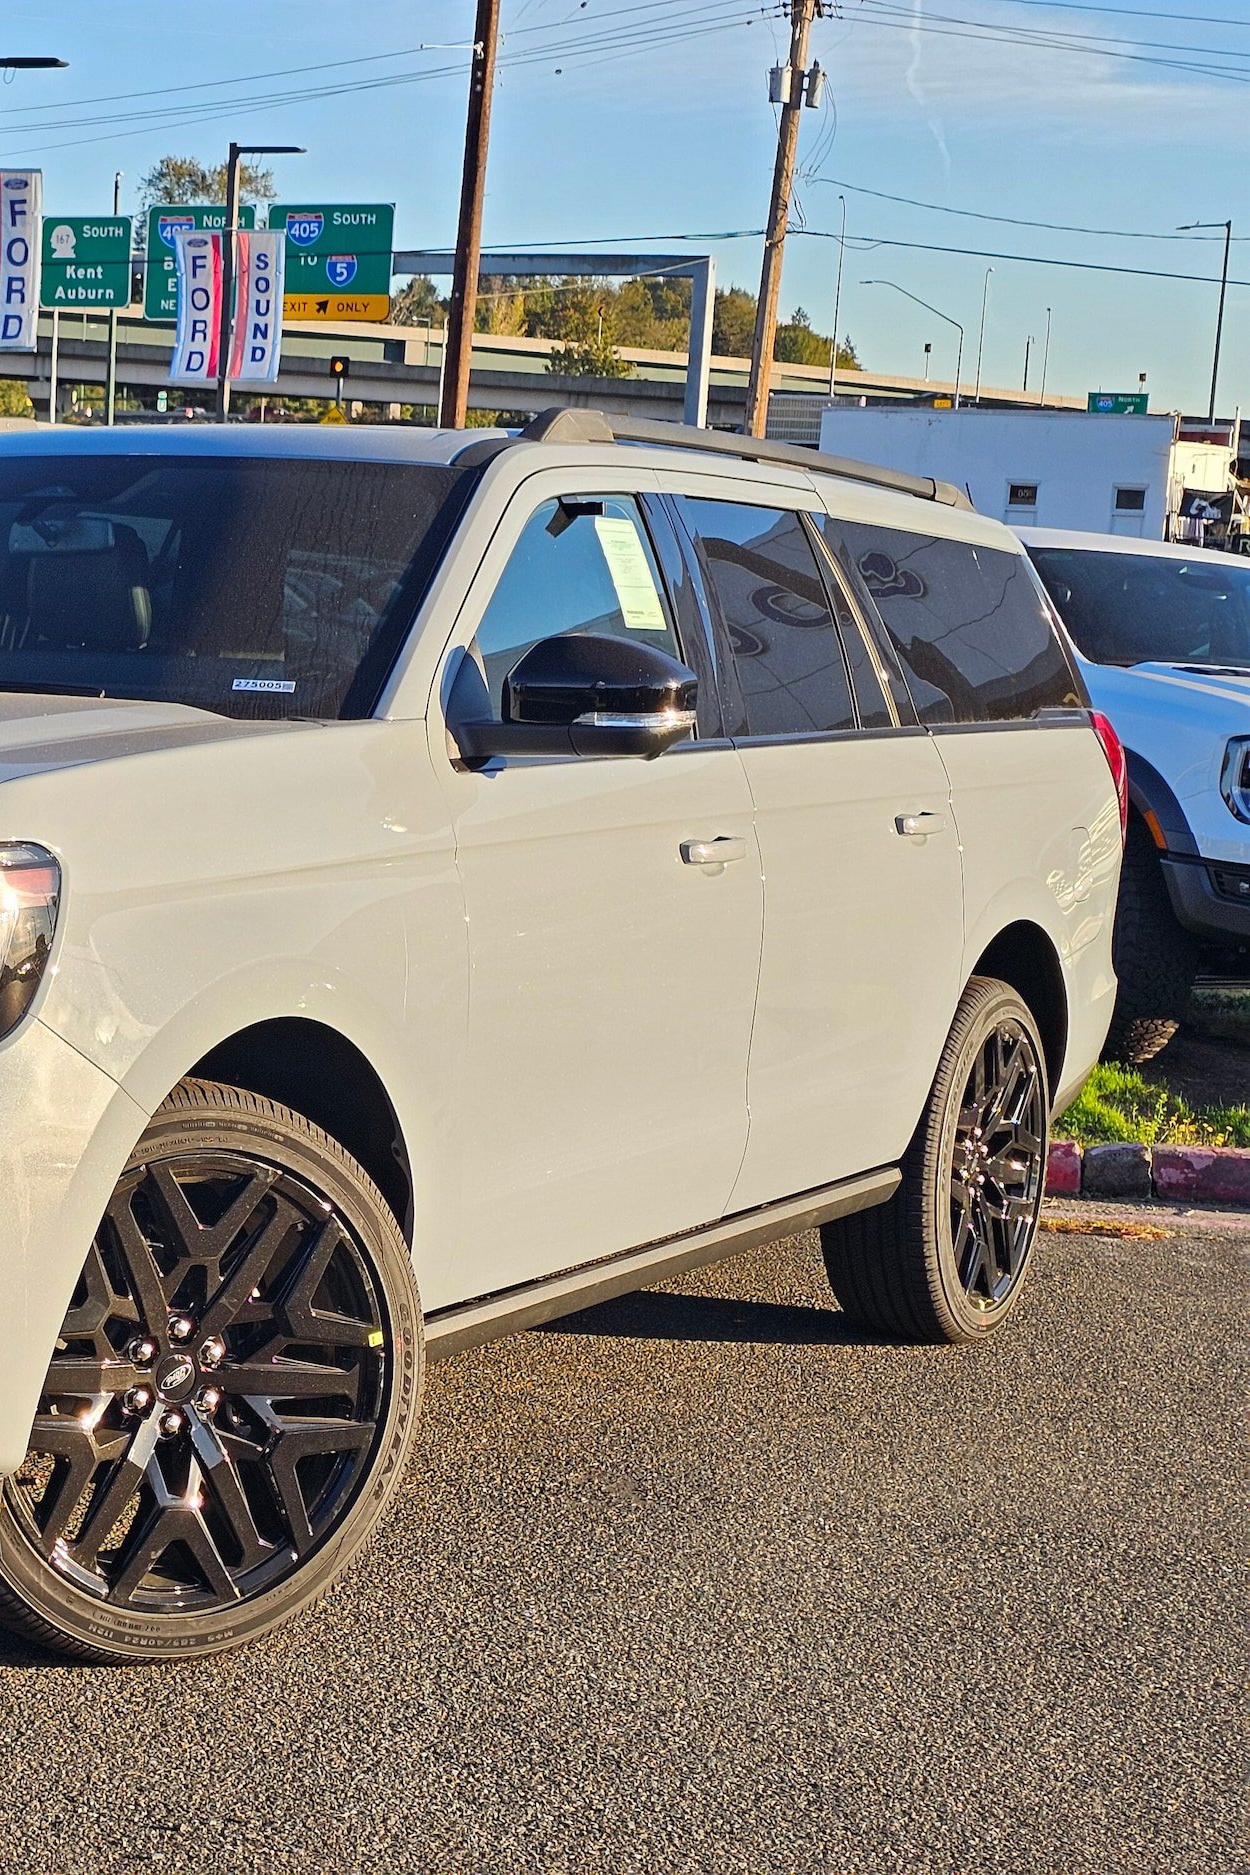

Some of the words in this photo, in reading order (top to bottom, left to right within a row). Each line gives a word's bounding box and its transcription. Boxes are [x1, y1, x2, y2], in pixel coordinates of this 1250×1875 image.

[56, 234, 70, 245] 167
[82, 225, 123, 238] SOUTH
[291, 223, 319, 238] 405
[333, 212, 376, 225] SOUTH
[2, 199, 29, 340] FORD
[66, 265, 103, 279] Kent
[335, 262, 348, 282] 5
[55, 285, 114, 300] Auburn
[185, 255, 210, 372] FORD
[250, 253, 270, 363] SOUND
[337, 302, 370, 312] ONLY
[235, 680, 283, 690] 275005
[371, 1302, 414, 1500] GOODYEAR
